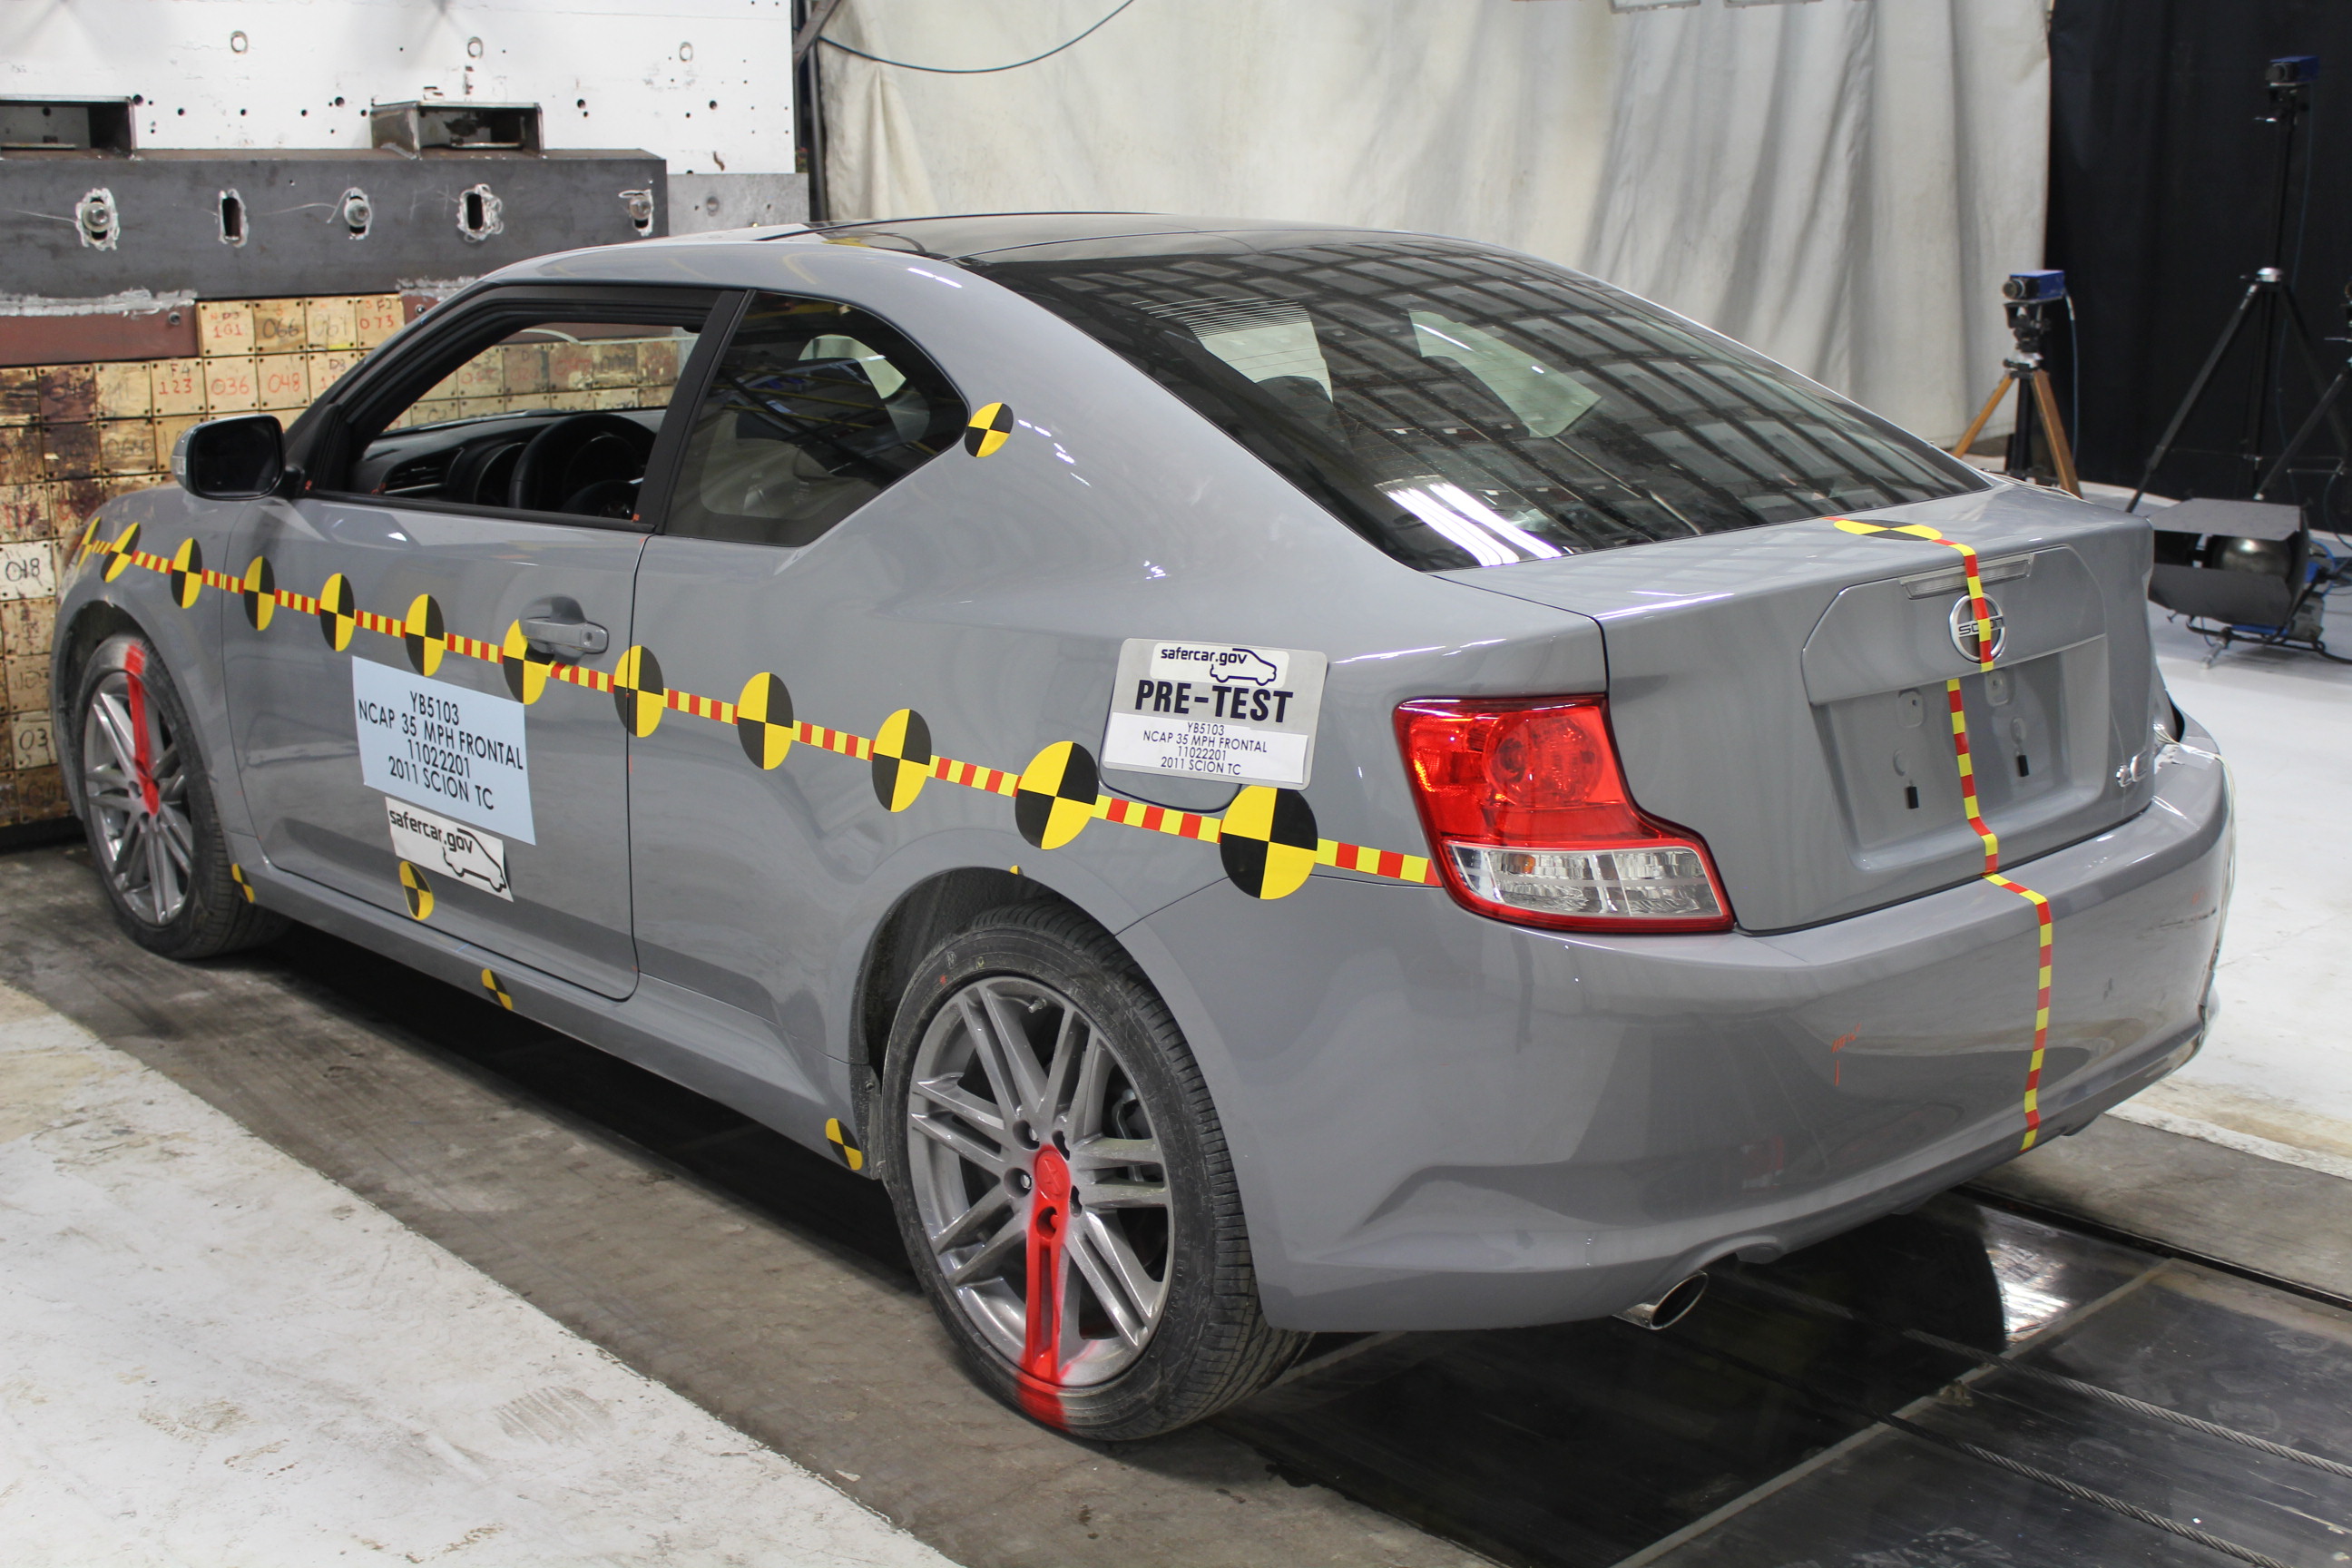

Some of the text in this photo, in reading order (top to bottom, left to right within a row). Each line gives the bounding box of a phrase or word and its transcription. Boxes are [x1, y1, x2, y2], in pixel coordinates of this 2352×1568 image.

[262, 318, 300, 339] 066
[359, 314, 394, 329] 073
[159, 377, 192, 396] 123
[211, 376, 250, 396] 036
[268, 372, 301, 394] 048
[5, 557, 41, 582] 018
[1161, 646, 1248, 665] safercar.gov
[410, 691, 460, 726] YB5103
[1134, 679, 1294, 723] PRE-TEST
[358, 699, 524, 770] NCAP 35 MPH FRONTAL
[1187, 721, 1225, 736] YB5103
[1143, 730, 1268, 753] NCAP 35 MPH FRONTAL
[407, 739, 471, 779] 11022201
[1178, 745, 1227, 761] 11022201
[1161, 756, 1242, 775] 2011 SCION TC
[388, 756, 495, 810] 2011 SCION TC
[389, 808, 474, 854] safercar.gov
